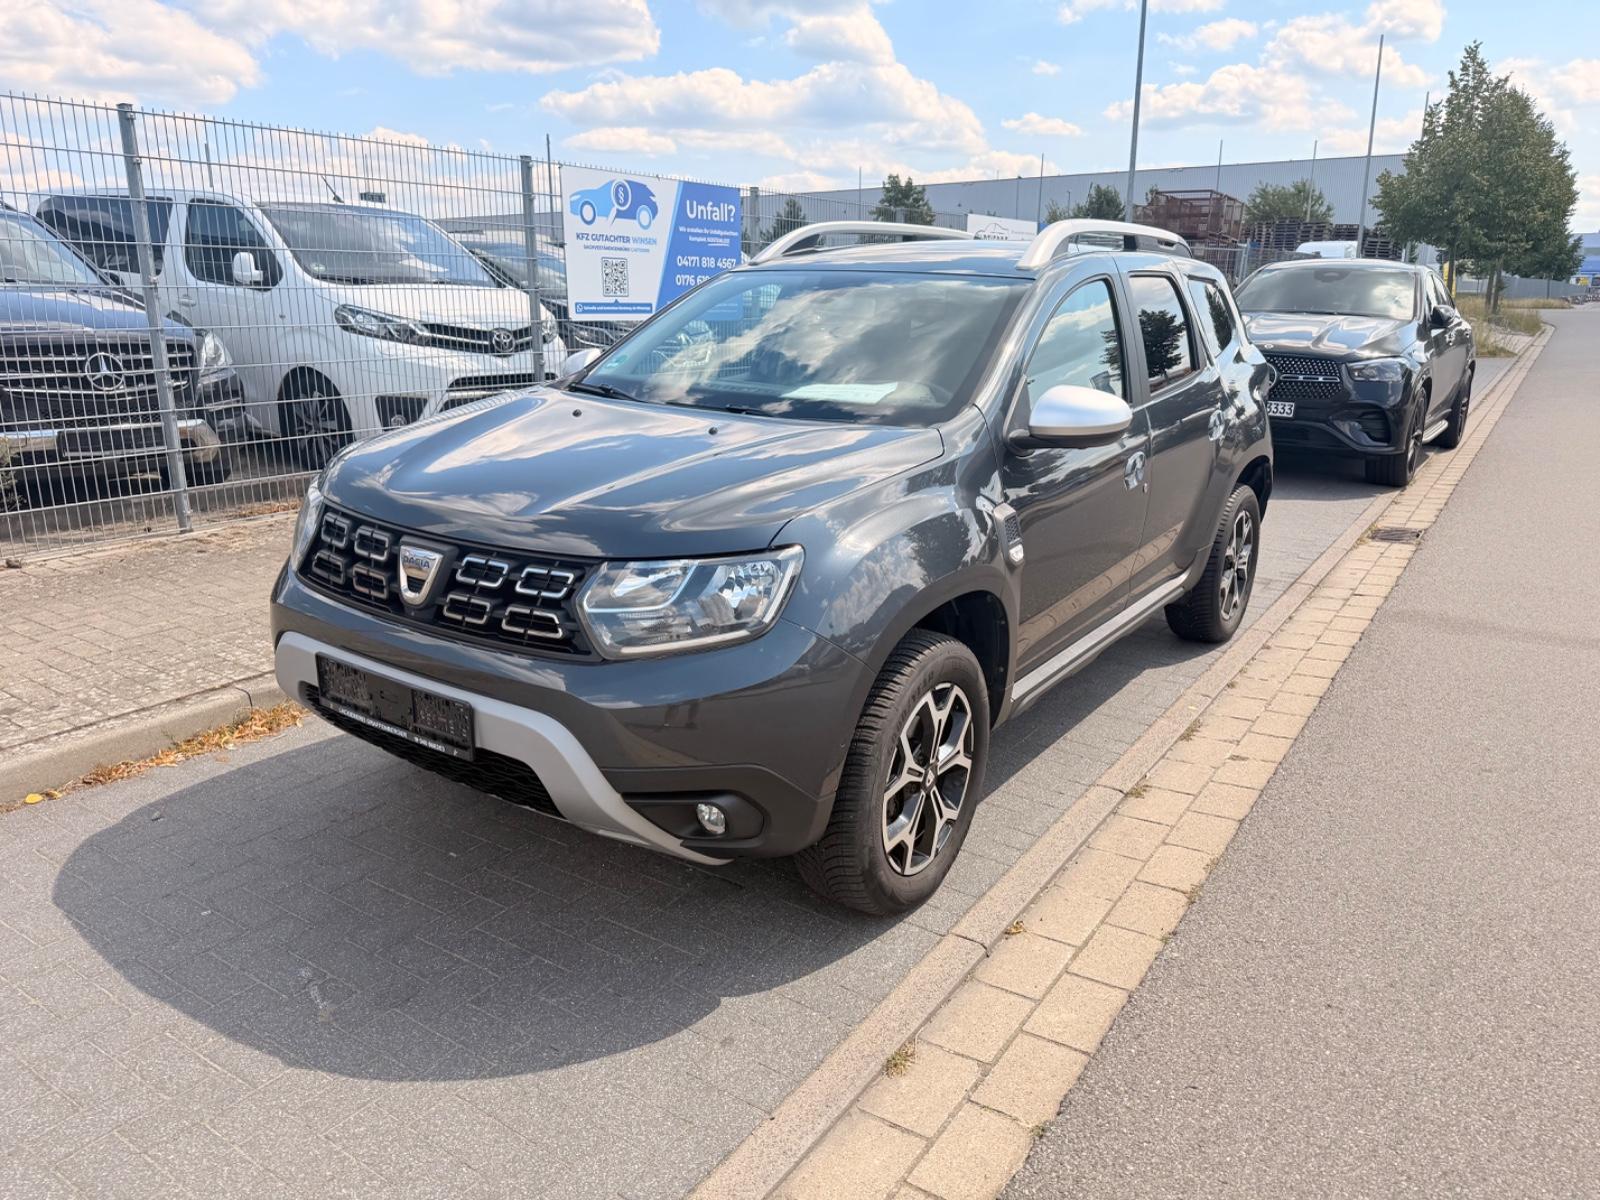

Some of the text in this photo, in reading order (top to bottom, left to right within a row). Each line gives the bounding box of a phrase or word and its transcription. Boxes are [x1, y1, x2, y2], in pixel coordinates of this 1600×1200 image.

[686, 199, 736, 223] Unfall?
[576, 232, 657, 245] KFZ GUTACHTER WINSEN
[677, 255, 736, 269] 04171 818 4567
[676, 274, 696, 286] 0176
